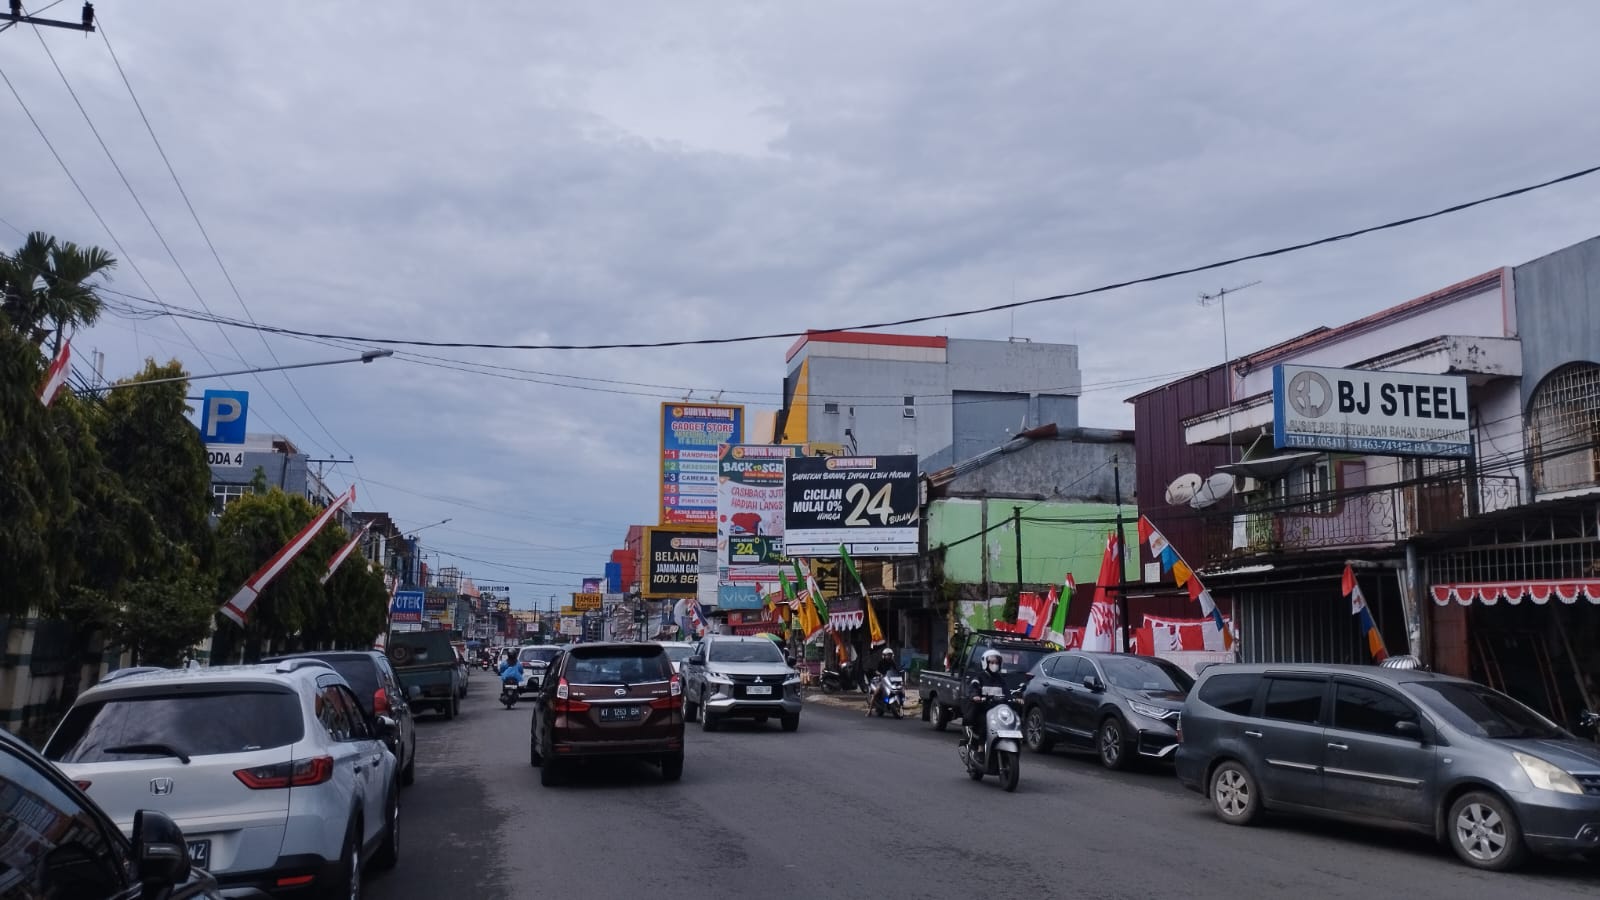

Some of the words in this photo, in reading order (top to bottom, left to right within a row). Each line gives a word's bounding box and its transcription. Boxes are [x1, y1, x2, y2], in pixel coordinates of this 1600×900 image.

[1338, 380, 1370, 415] BJ
[1380, 382, 1466, 420] STEEL
[207, 397, 242, 437] P
[672, 421, 705, 432] GADGET
[706, 422, 734, 434] STORE
[1370, 424, 1387, 437] DAN
[1389, 425, 1417, 439] BAHAN
[207, 452, 231, 465] ODA
[234, 453, 242, 465] 4
[722, 462, 753, 473] BACK
[762, 464, 784, 473] SCH
[670, 473, 676, 481] 3
[670, 485, 676, 493] 5
[731, 487, 767, 498] CASHBACK
[670, 497, 676, 505] 6
[803, 489, 842, 500] CICILAN
[844, 482, 894, 526] 24
[792, 502, 824, 512] MULAI
[826, 502, 843, 512] 0%
[816, 513, 841, 521] HINGGA
[888, 511, 911, 524] BULAN
[736, 542, 753, 555] 24
[655, 551, 697, 562] BELANJA
[656, 563, 685, 573] JAMINAN
[653, 574, 677, 584] 100%
[724, 592, 758, 602] vivo
